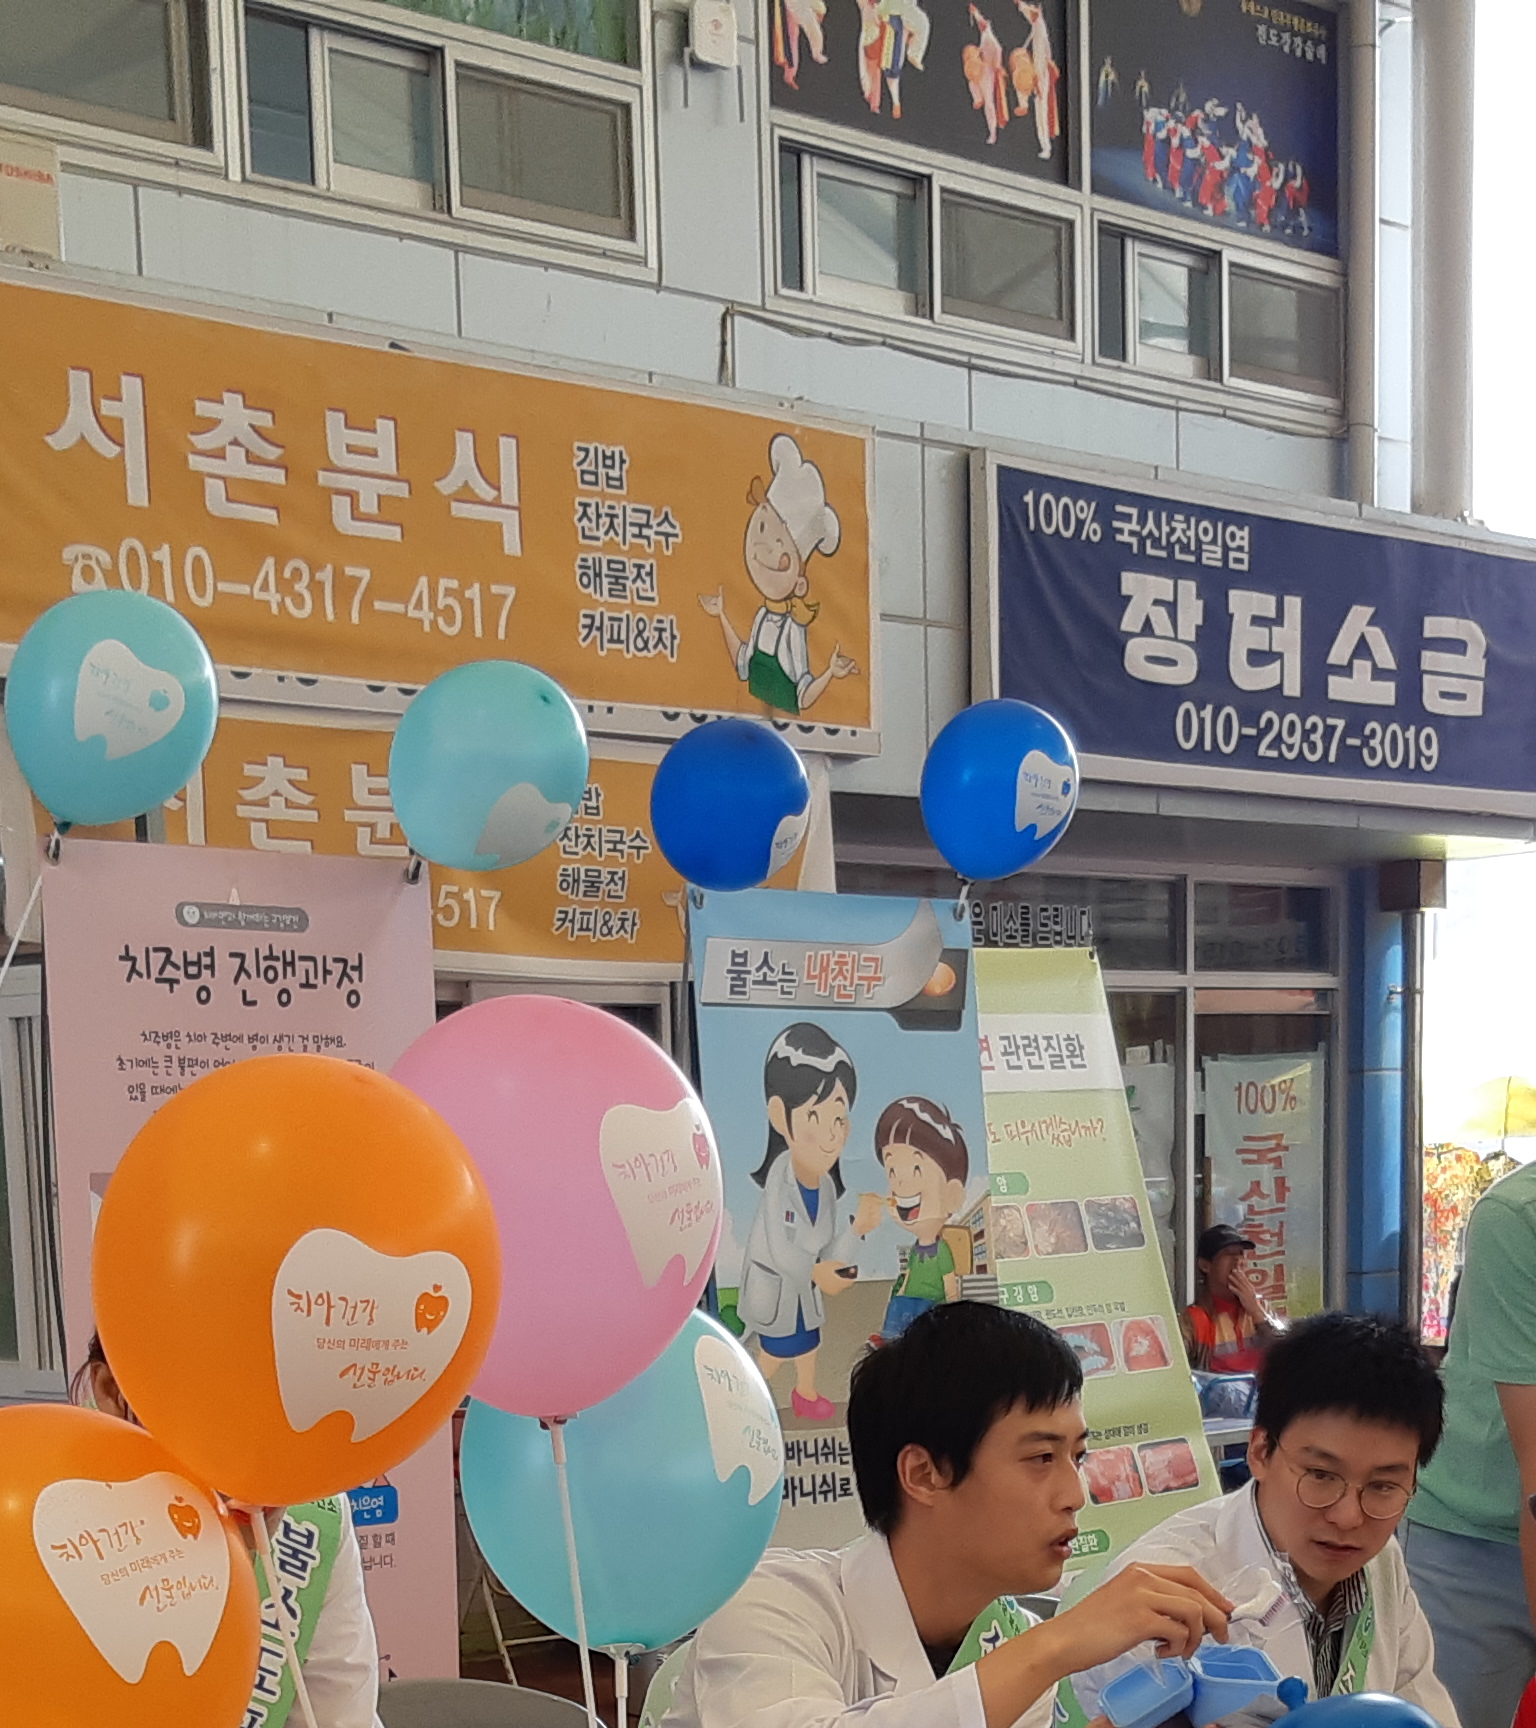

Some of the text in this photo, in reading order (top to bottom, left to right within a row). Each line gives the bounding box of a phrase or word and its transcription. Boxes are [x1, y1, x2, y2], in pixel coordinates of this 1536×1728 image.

[47, 366, 522, 558] 서촌분식
[574, 445, 627, 491] 김밥
[574, 501, 681, 554] 잔치국수
[1021, 490, 1252, 572] 100% 국산천일염
[120, 538, 518, 642] 010-4317-4517
[577, 557, 658, 603] 해물전
[577, 614, 679, 662] 커피&차
[1120, 571, 1488, 718] 장터소금
[1174, 701, 1440, 773] 010-2937-3019
[559, 824, 651, 863] 잔치국수
[557, 864, 627, 902] 해물전
[552, 905, 640, 943] 커피&차
[989, 901, 1094, 948] 미소를 드립니다
[119, 943, 365, 1008] 치주병 진행과정
[725, 948, 884, 998] 불소는 내친구
[998, 1033, 1088, 1071] 관련질환
[1234, 1078, 1297, 1115] 100%
